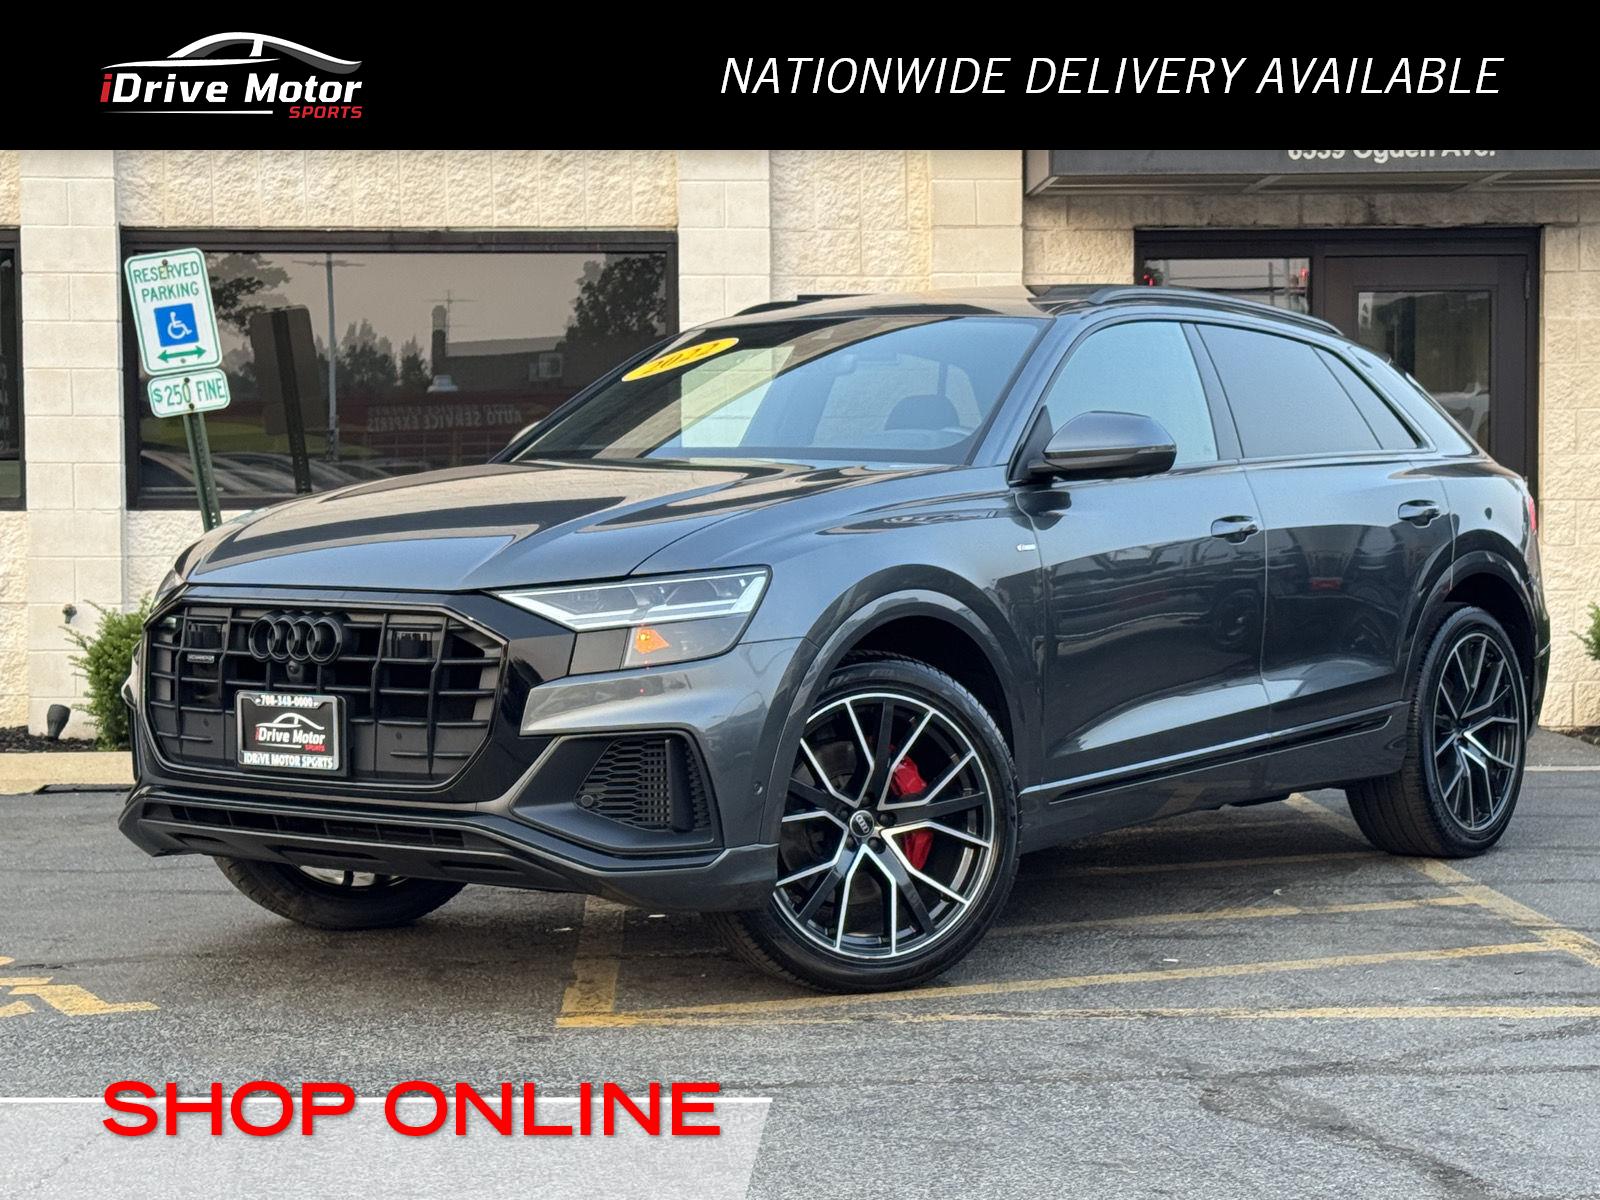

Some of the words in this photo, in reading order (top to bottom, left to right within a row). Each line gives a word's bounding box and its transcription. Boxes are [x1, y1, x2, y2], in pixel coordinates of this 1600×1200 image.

[133, 261, 200, 284] RESERVED
[141, 281, 200, 303] PARKING
[152, 382, 192, 407] $250
[195, 378, 226, 402] FINE
[292, 729, 326, 745] Motor
[271, 754, 300, 768] MOTOR
[302, 756, 333, 769] SPORTS
